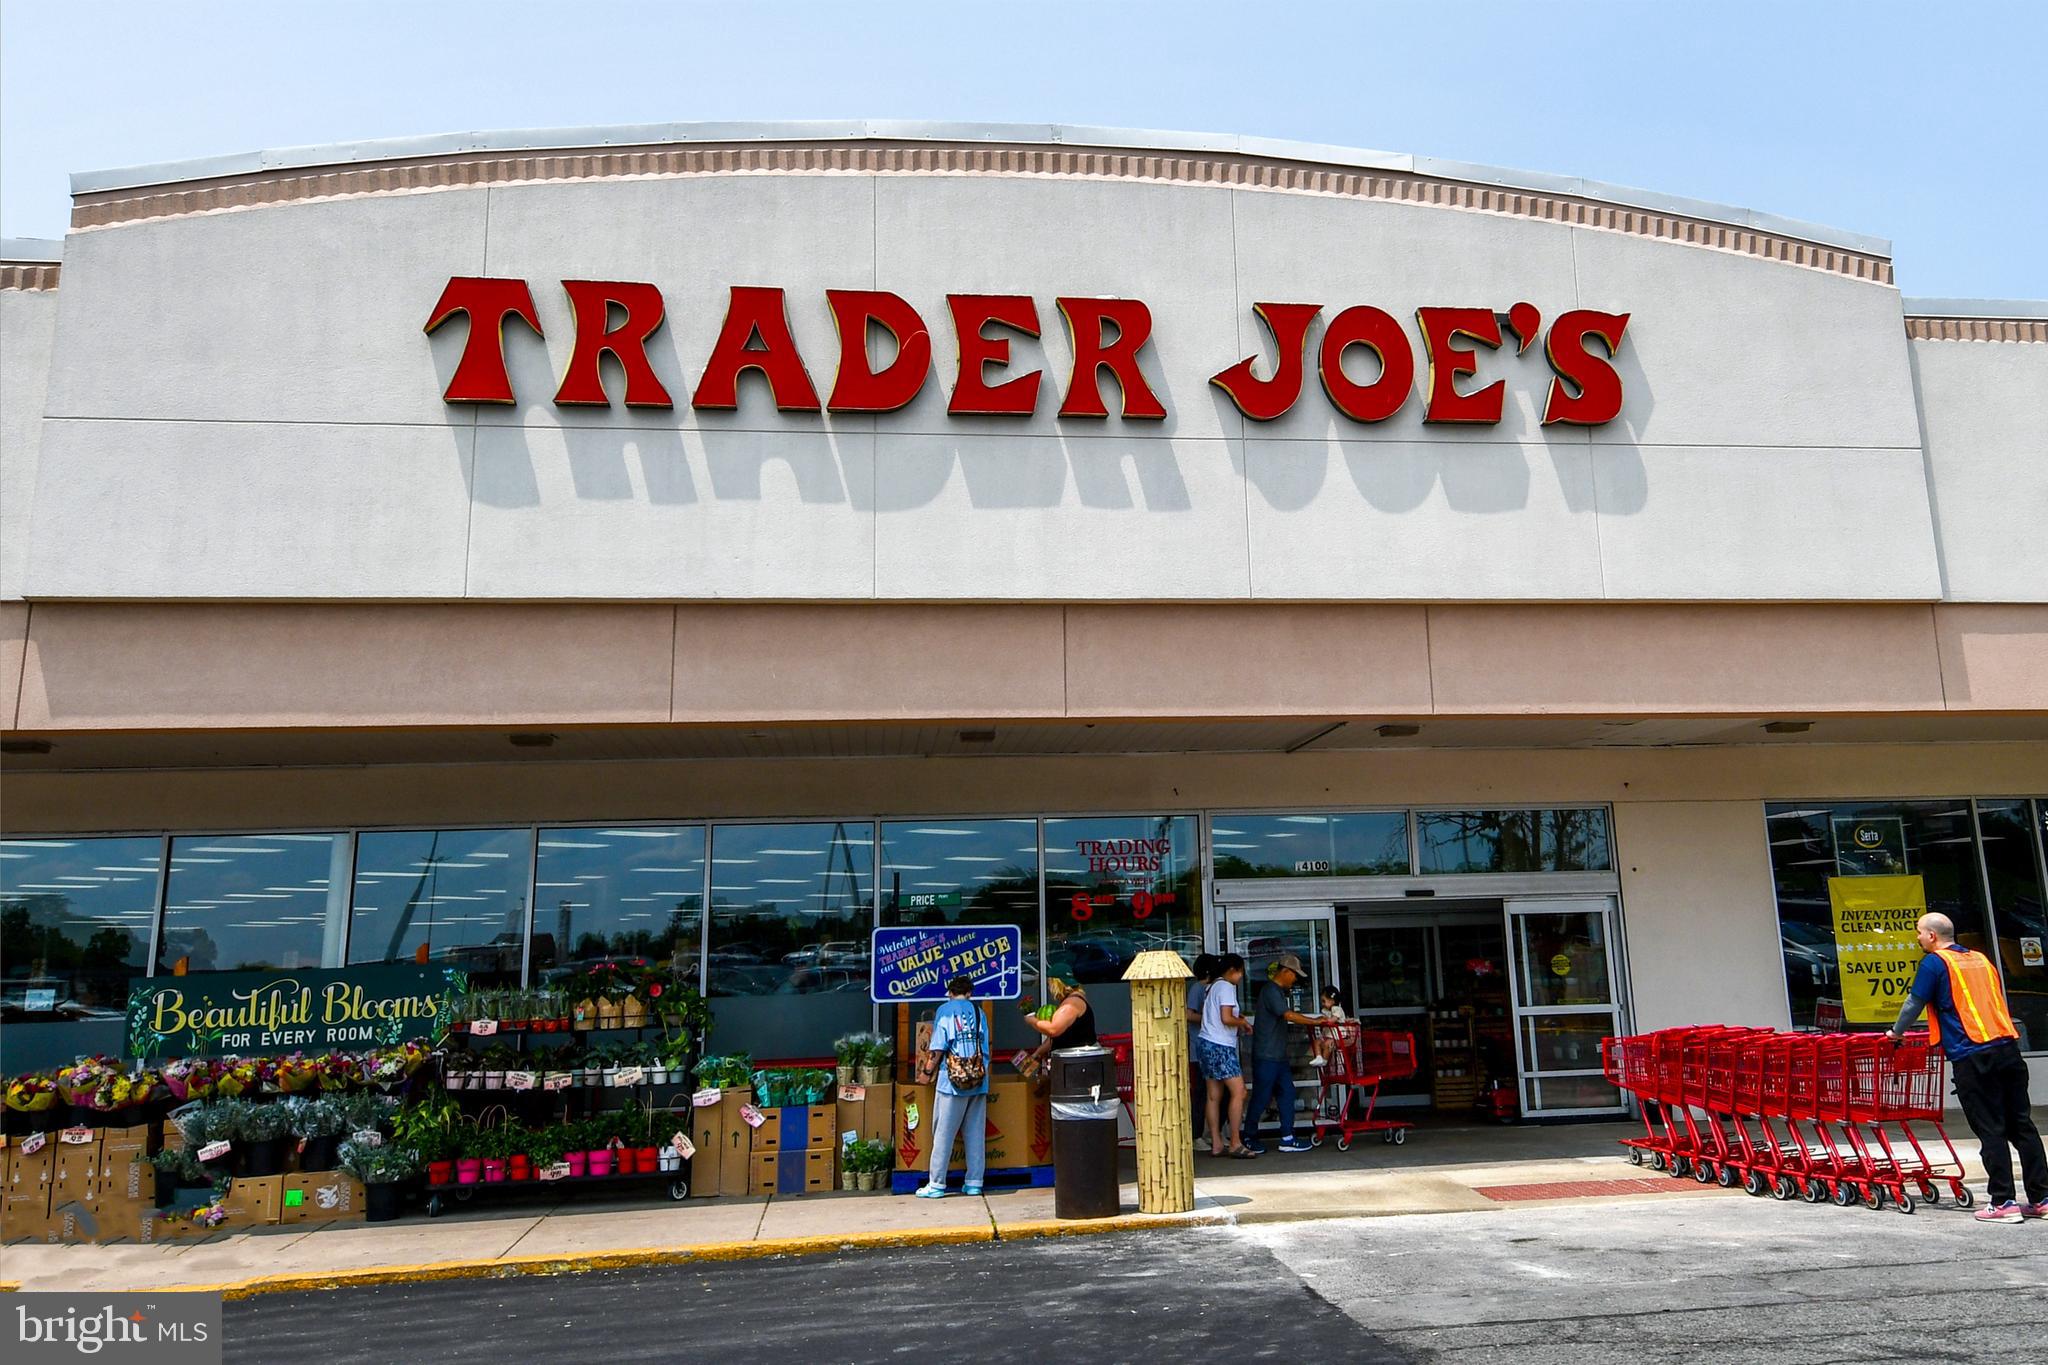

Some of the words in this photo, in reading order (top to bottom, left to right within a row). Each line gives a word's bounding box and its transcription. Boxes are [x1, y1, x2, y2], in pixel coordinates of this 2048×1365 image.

[423, 276, 1166, 419] TRADER
[1208, 302, 1631, 426] JOE'S
[1860, 829, 1879, 842] Serta
[1076, 839, 1171, 856] TRADING
[1089, 855, 1160, 873] HOURS
[1301, 861, 1328, 871] 4100
[911, 894, 935, 906] PRICE
[1840, 908, 1921, 921] INVENTORY
[878, 936, 918, 955] Welcome
[897, 945, 945, 973] VALUE
[950, 931, 977, 947] where
[879, 945, 917, 966] TRADER
[888, 966, 940, 996] Quality
[948, 936, 1011, 973] PRICE
[1846, 961, 1883, 974] SAVE
[1887, 961, 1906, 973] UP
[149, 978, 314, 1034] Beautiful
[321, 981, 449, 1026] Blooms
[221, 1032, 251, 1048] FOR
[260, 1029, 317, 1046] EVERY
[326, 1026, 373, 1042] ROOM
